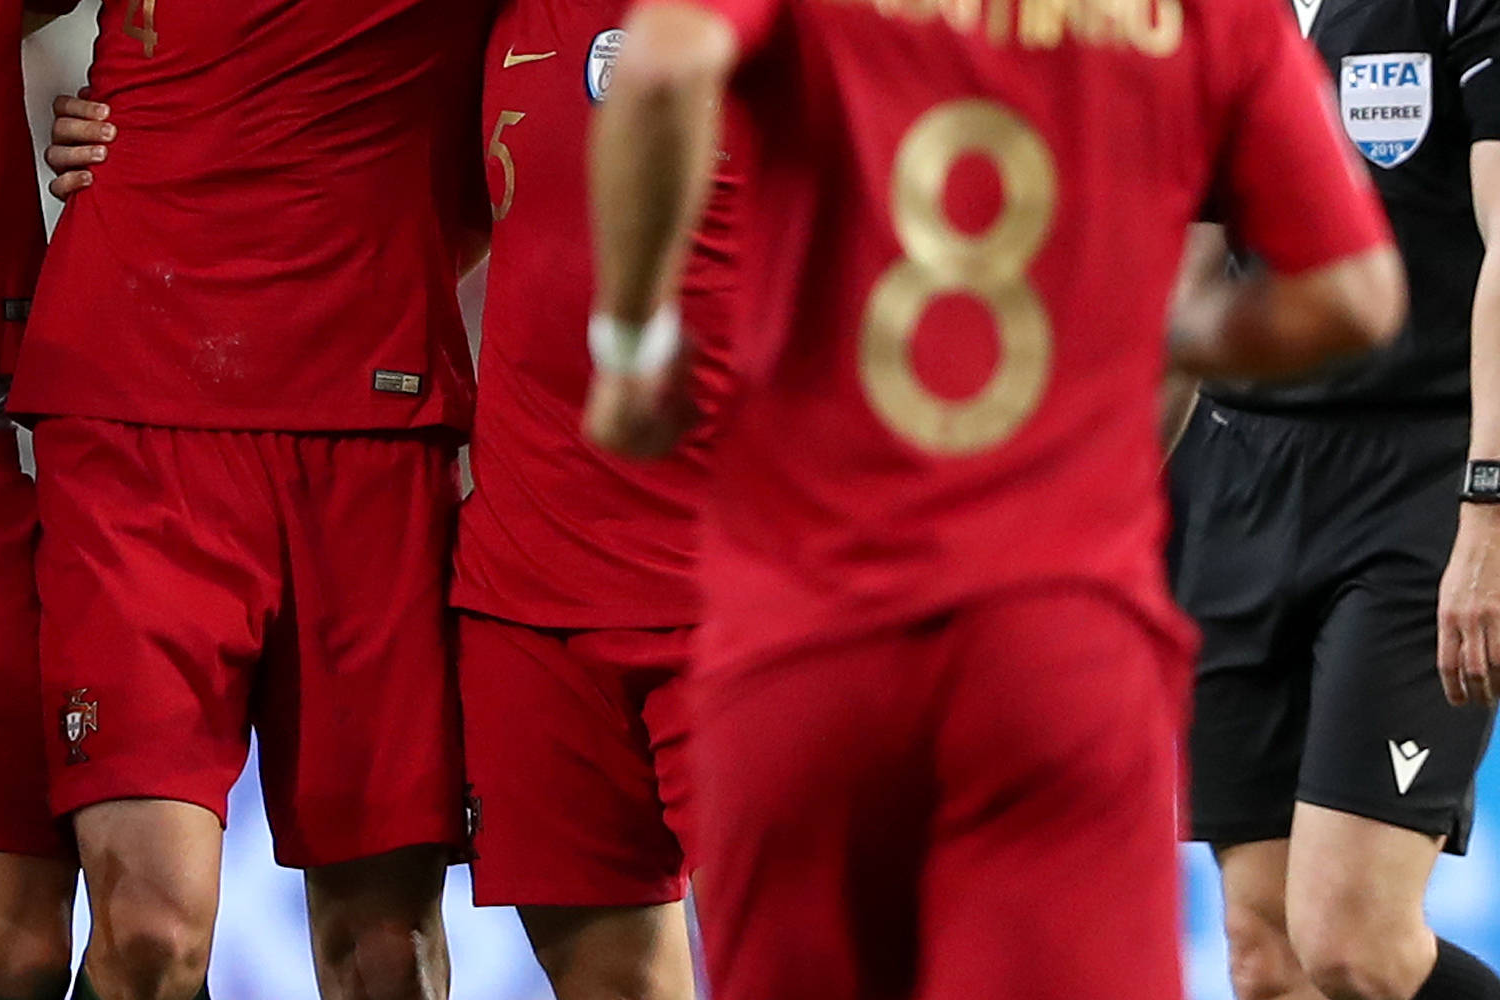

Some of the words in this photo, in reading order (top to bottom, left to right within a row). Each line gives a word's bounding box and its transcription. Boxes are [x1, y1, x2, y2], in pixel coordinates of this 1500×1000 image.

[1350, 62, 1421, 88] FIFA
[1350, 106, 1422, 121] REFEREE
[1371, 142, 1404, 157] 2019
[488, 110, 526, 221] 5
[858, 97, 1060, 459] 8
